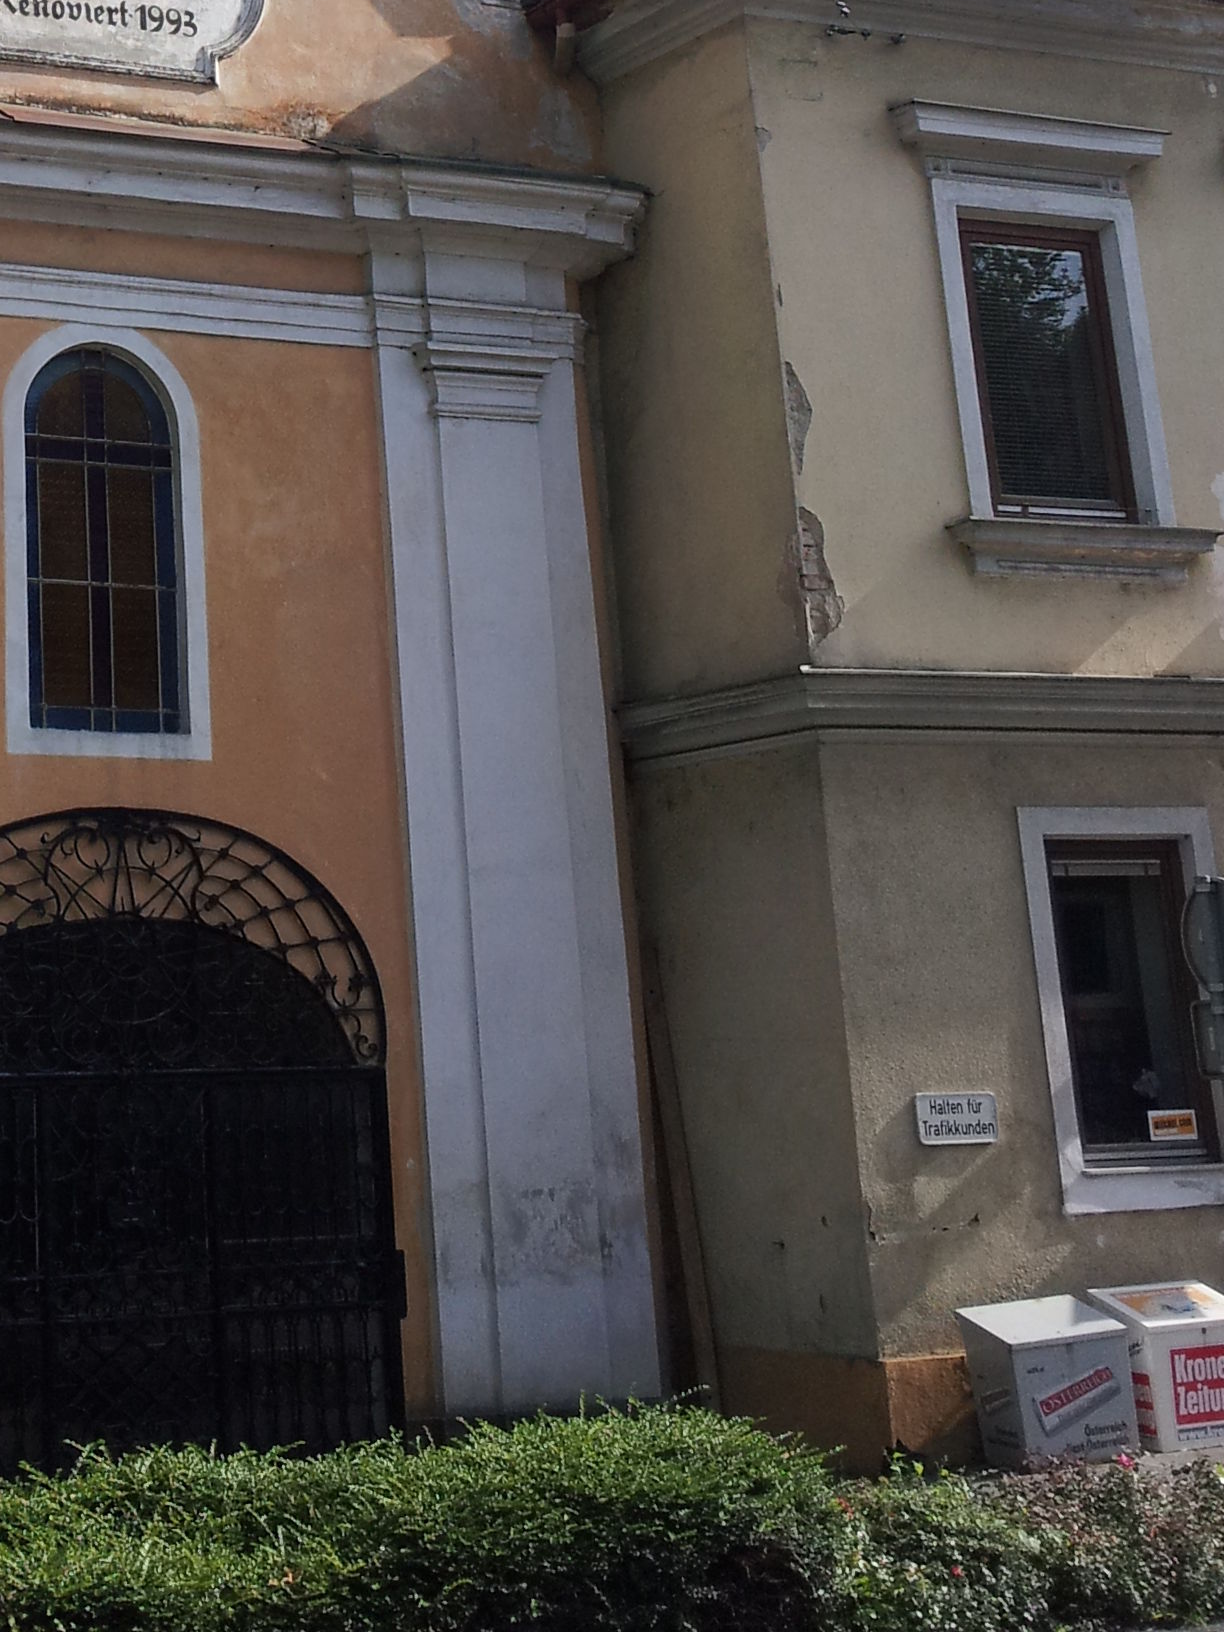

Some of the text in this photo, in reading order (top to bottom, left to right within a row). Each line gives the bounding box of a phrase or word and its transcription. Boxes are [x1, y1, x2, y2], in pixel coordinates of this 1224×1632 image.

[135, 4, 198, 37] 1993
[929, 1098, 982, 1115] Halten für
[922, 1119, 995, 1136] Trafikkunden
